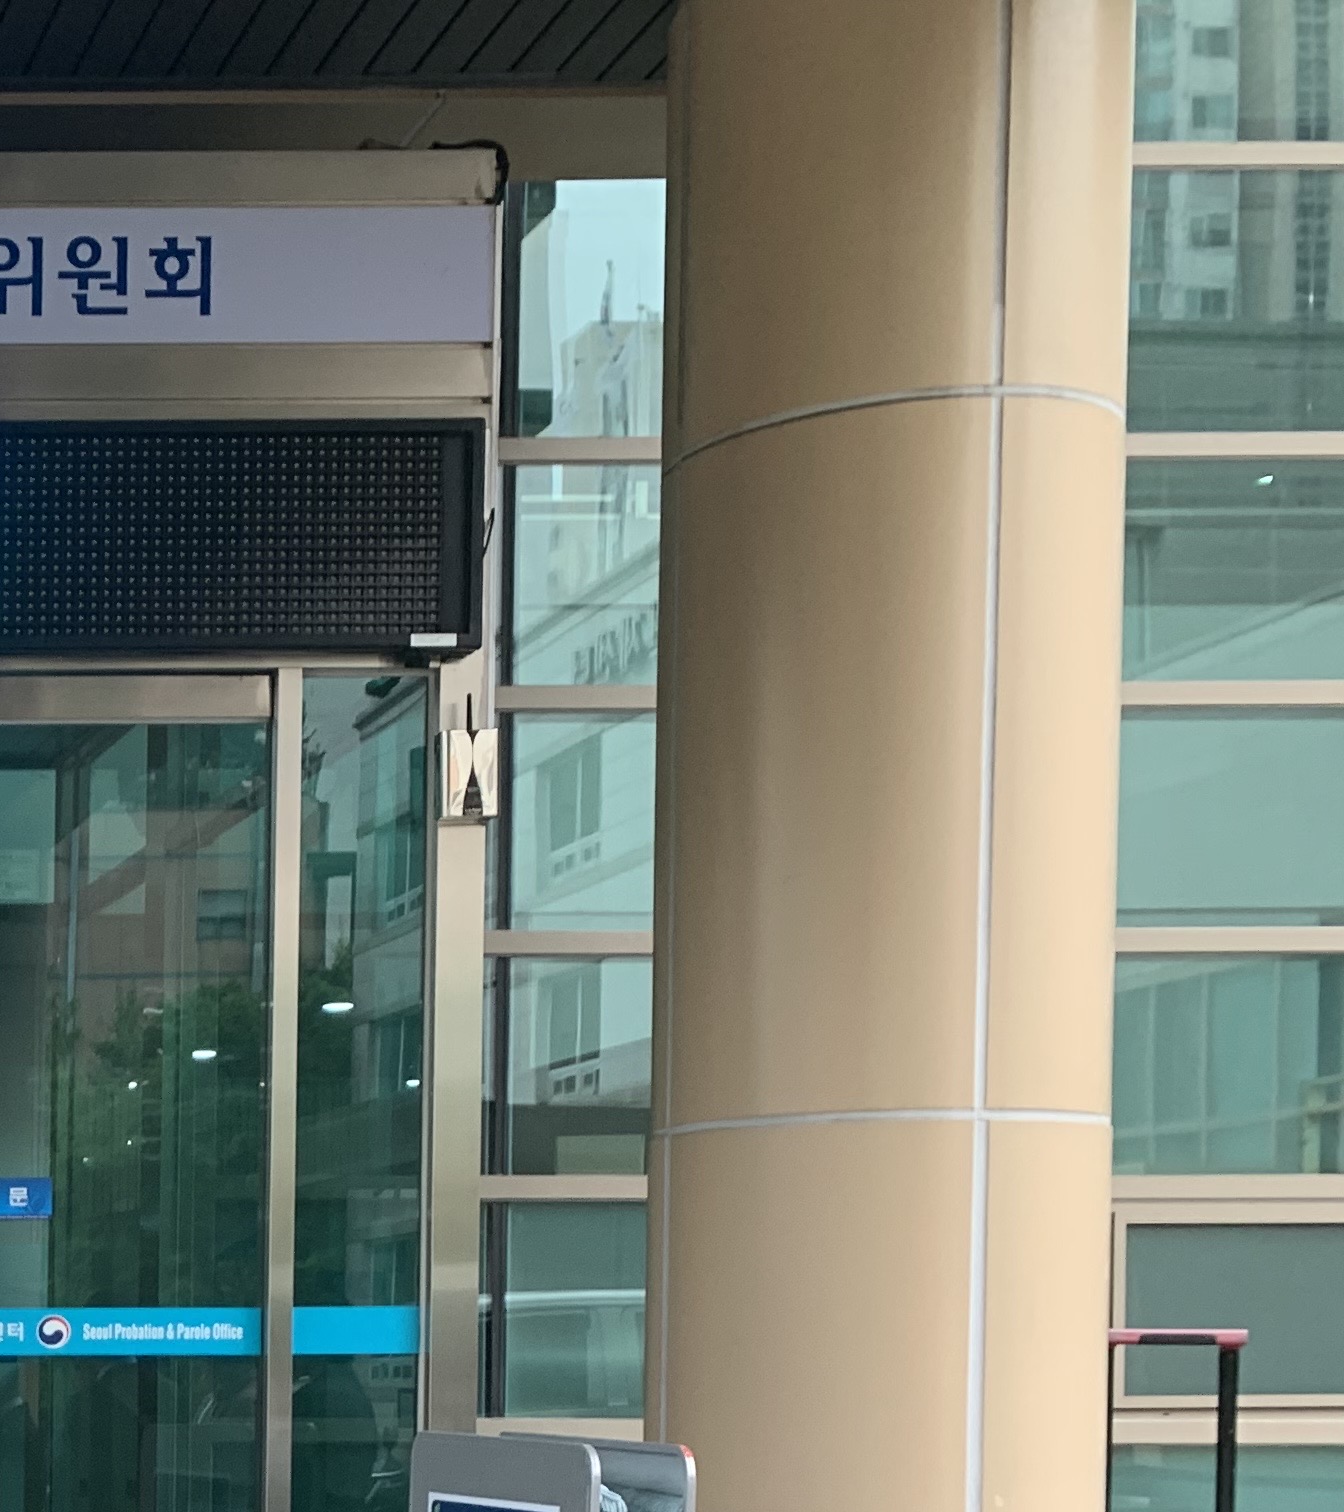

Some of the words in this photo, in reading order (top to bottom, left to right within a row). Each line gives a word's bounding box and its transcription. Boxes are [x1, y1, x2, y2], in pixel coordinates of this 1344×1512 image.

[82, 1322, 113, 1340] Seoul
[114, 1322, 165, 1341] Probation
[166, 1322, 174, 1340] &
[176, 1322, 211, 1340] Parole
[212, 1322, 244, 1340] Office
